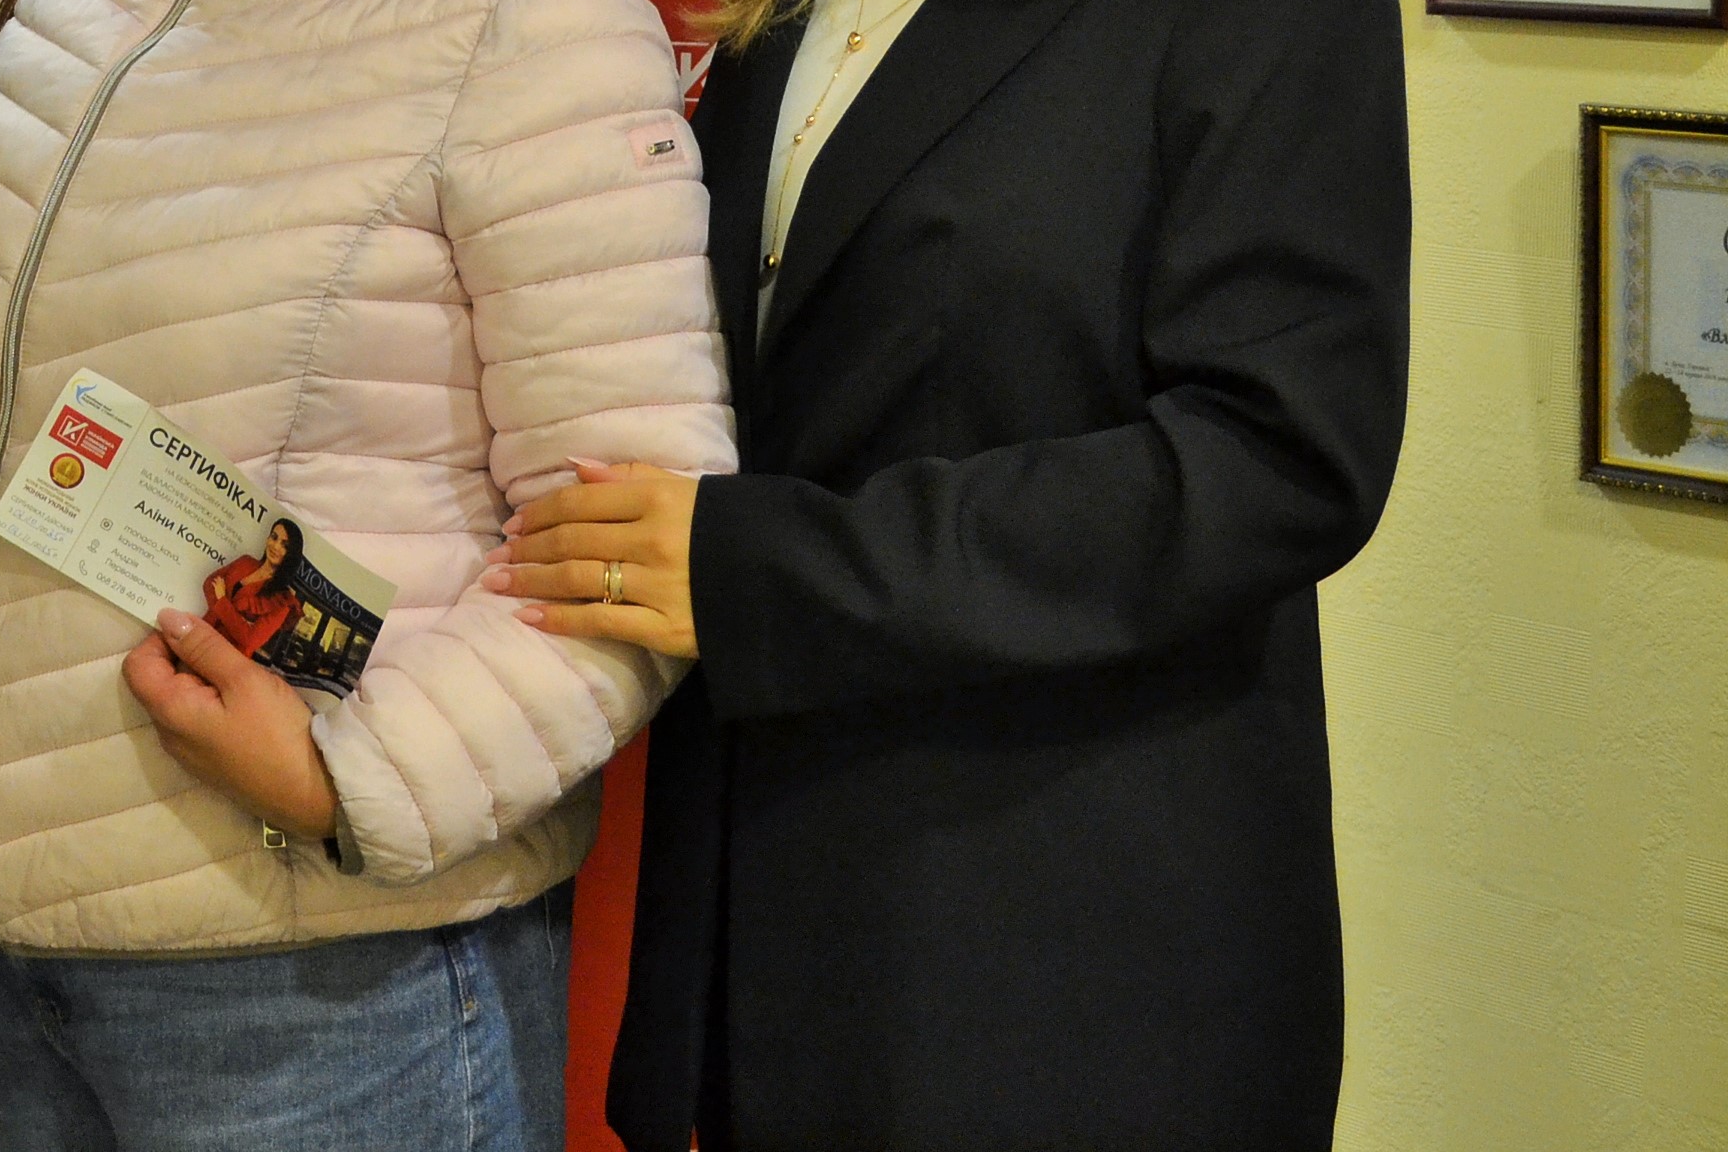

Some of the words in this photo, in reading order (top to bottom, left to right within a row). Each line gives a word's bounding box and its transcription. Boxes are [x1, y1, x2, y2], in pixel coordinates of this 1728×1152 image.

[150, 428, 268, 523] СЕРТИФІКАТ
[135, 500, 175, 530] Аліни
[177, 524, 227, 565] Костюк
[297, 560, 361, 620] MONACO
